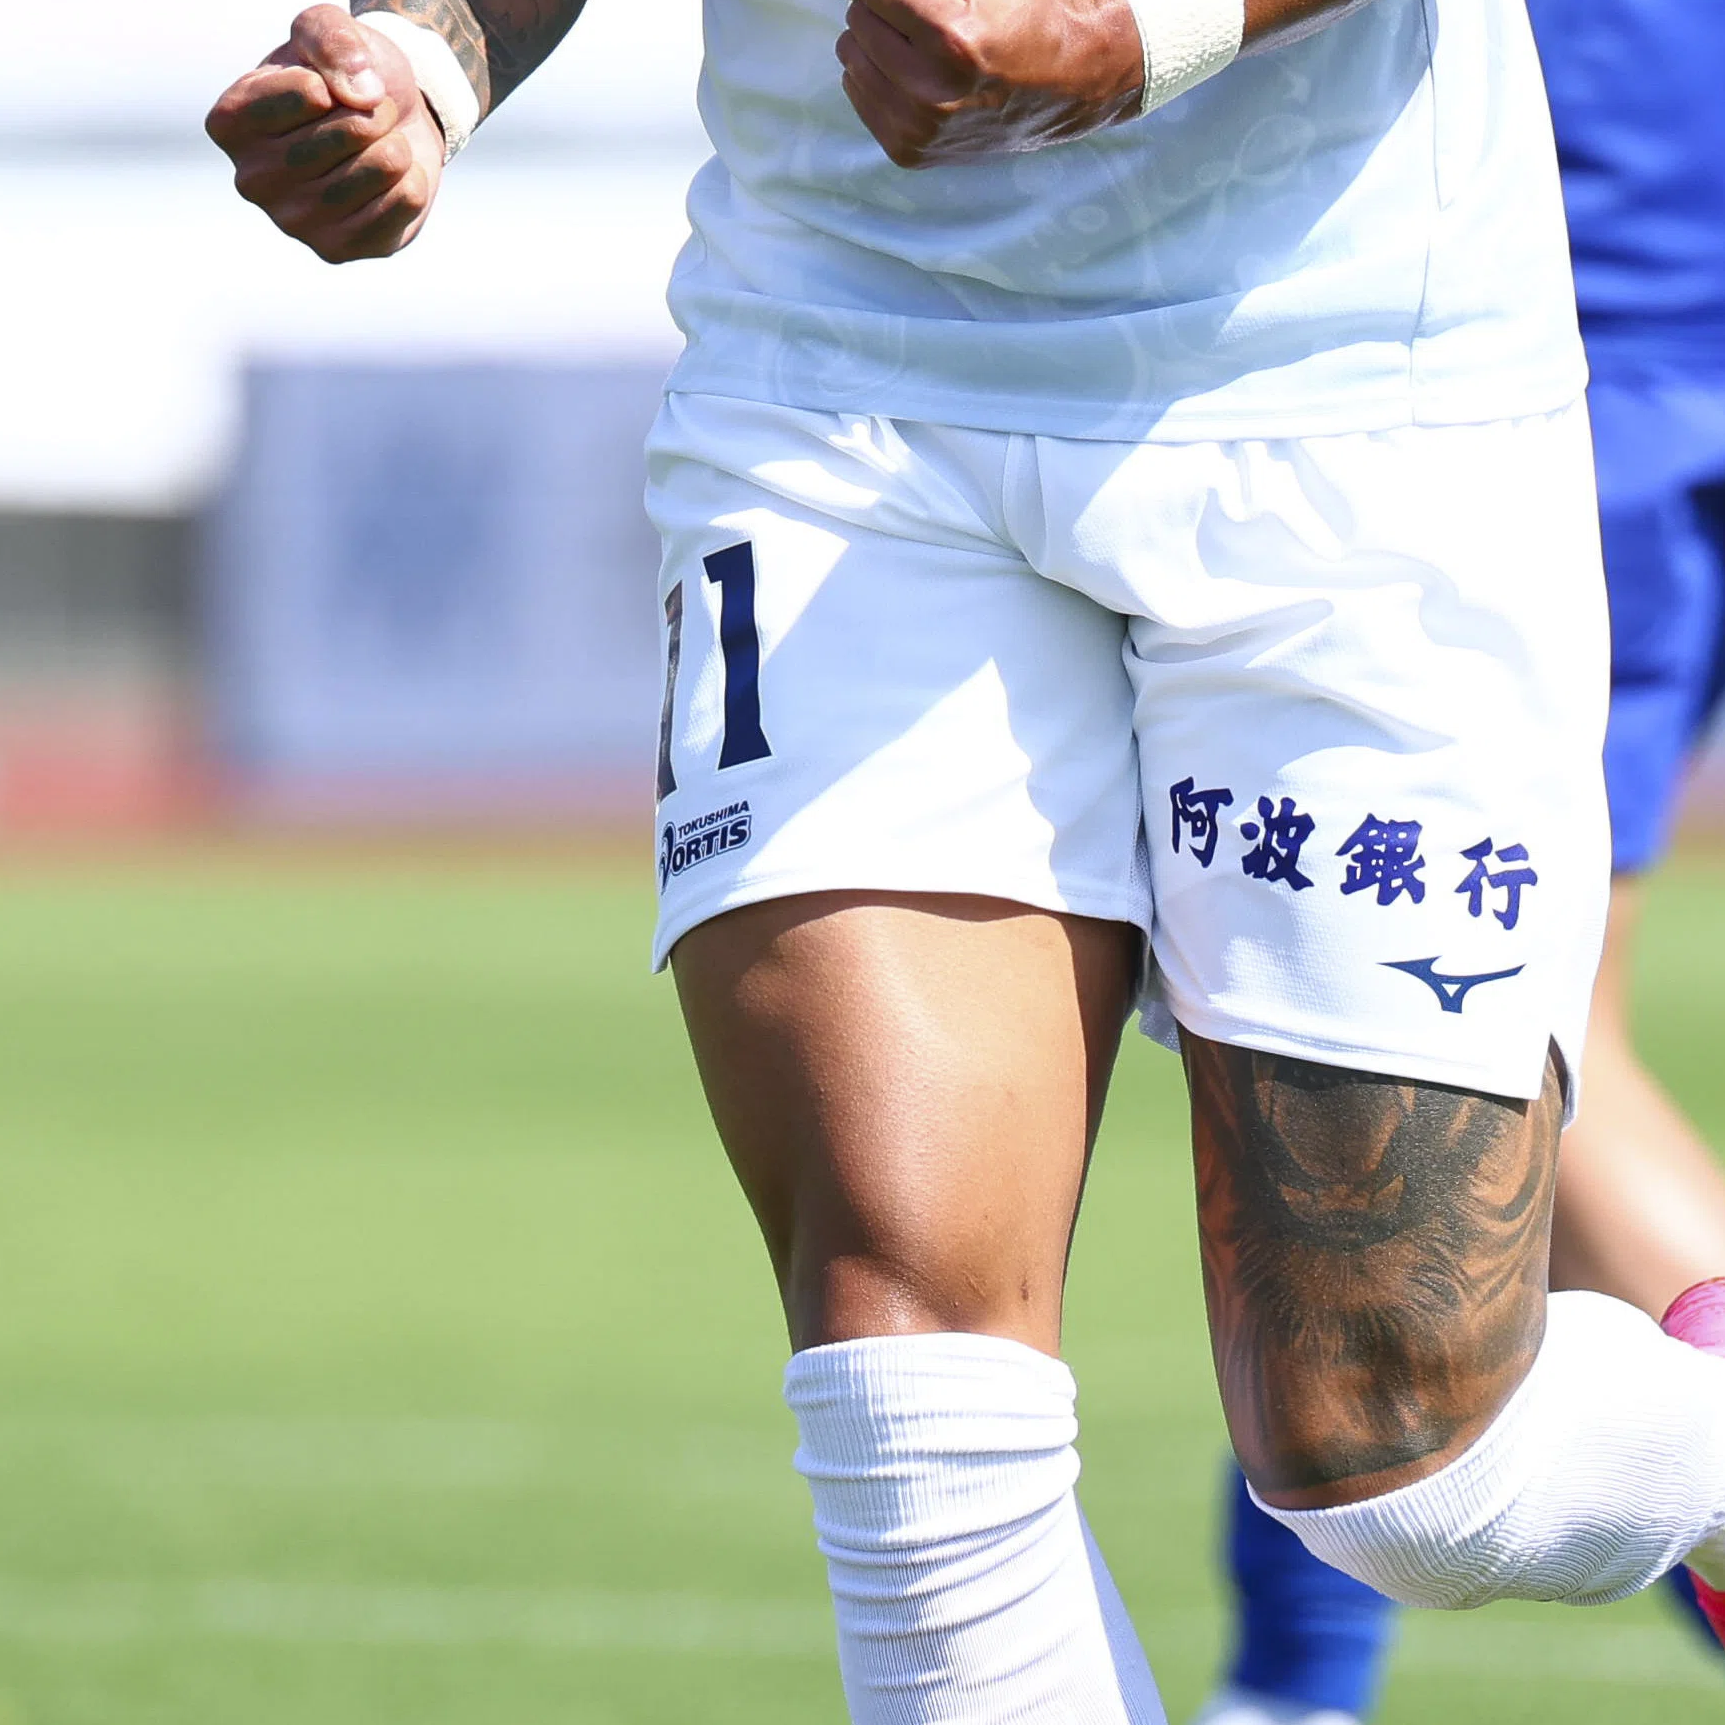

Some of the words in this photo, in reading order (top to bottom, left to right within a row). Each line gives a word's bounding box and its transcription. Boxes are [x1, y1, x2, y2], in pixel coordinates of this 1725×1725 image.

[678, 800, 749, 839] TOKUSHIMA
[1170, 776, 1538, 931] 阿波銀行
